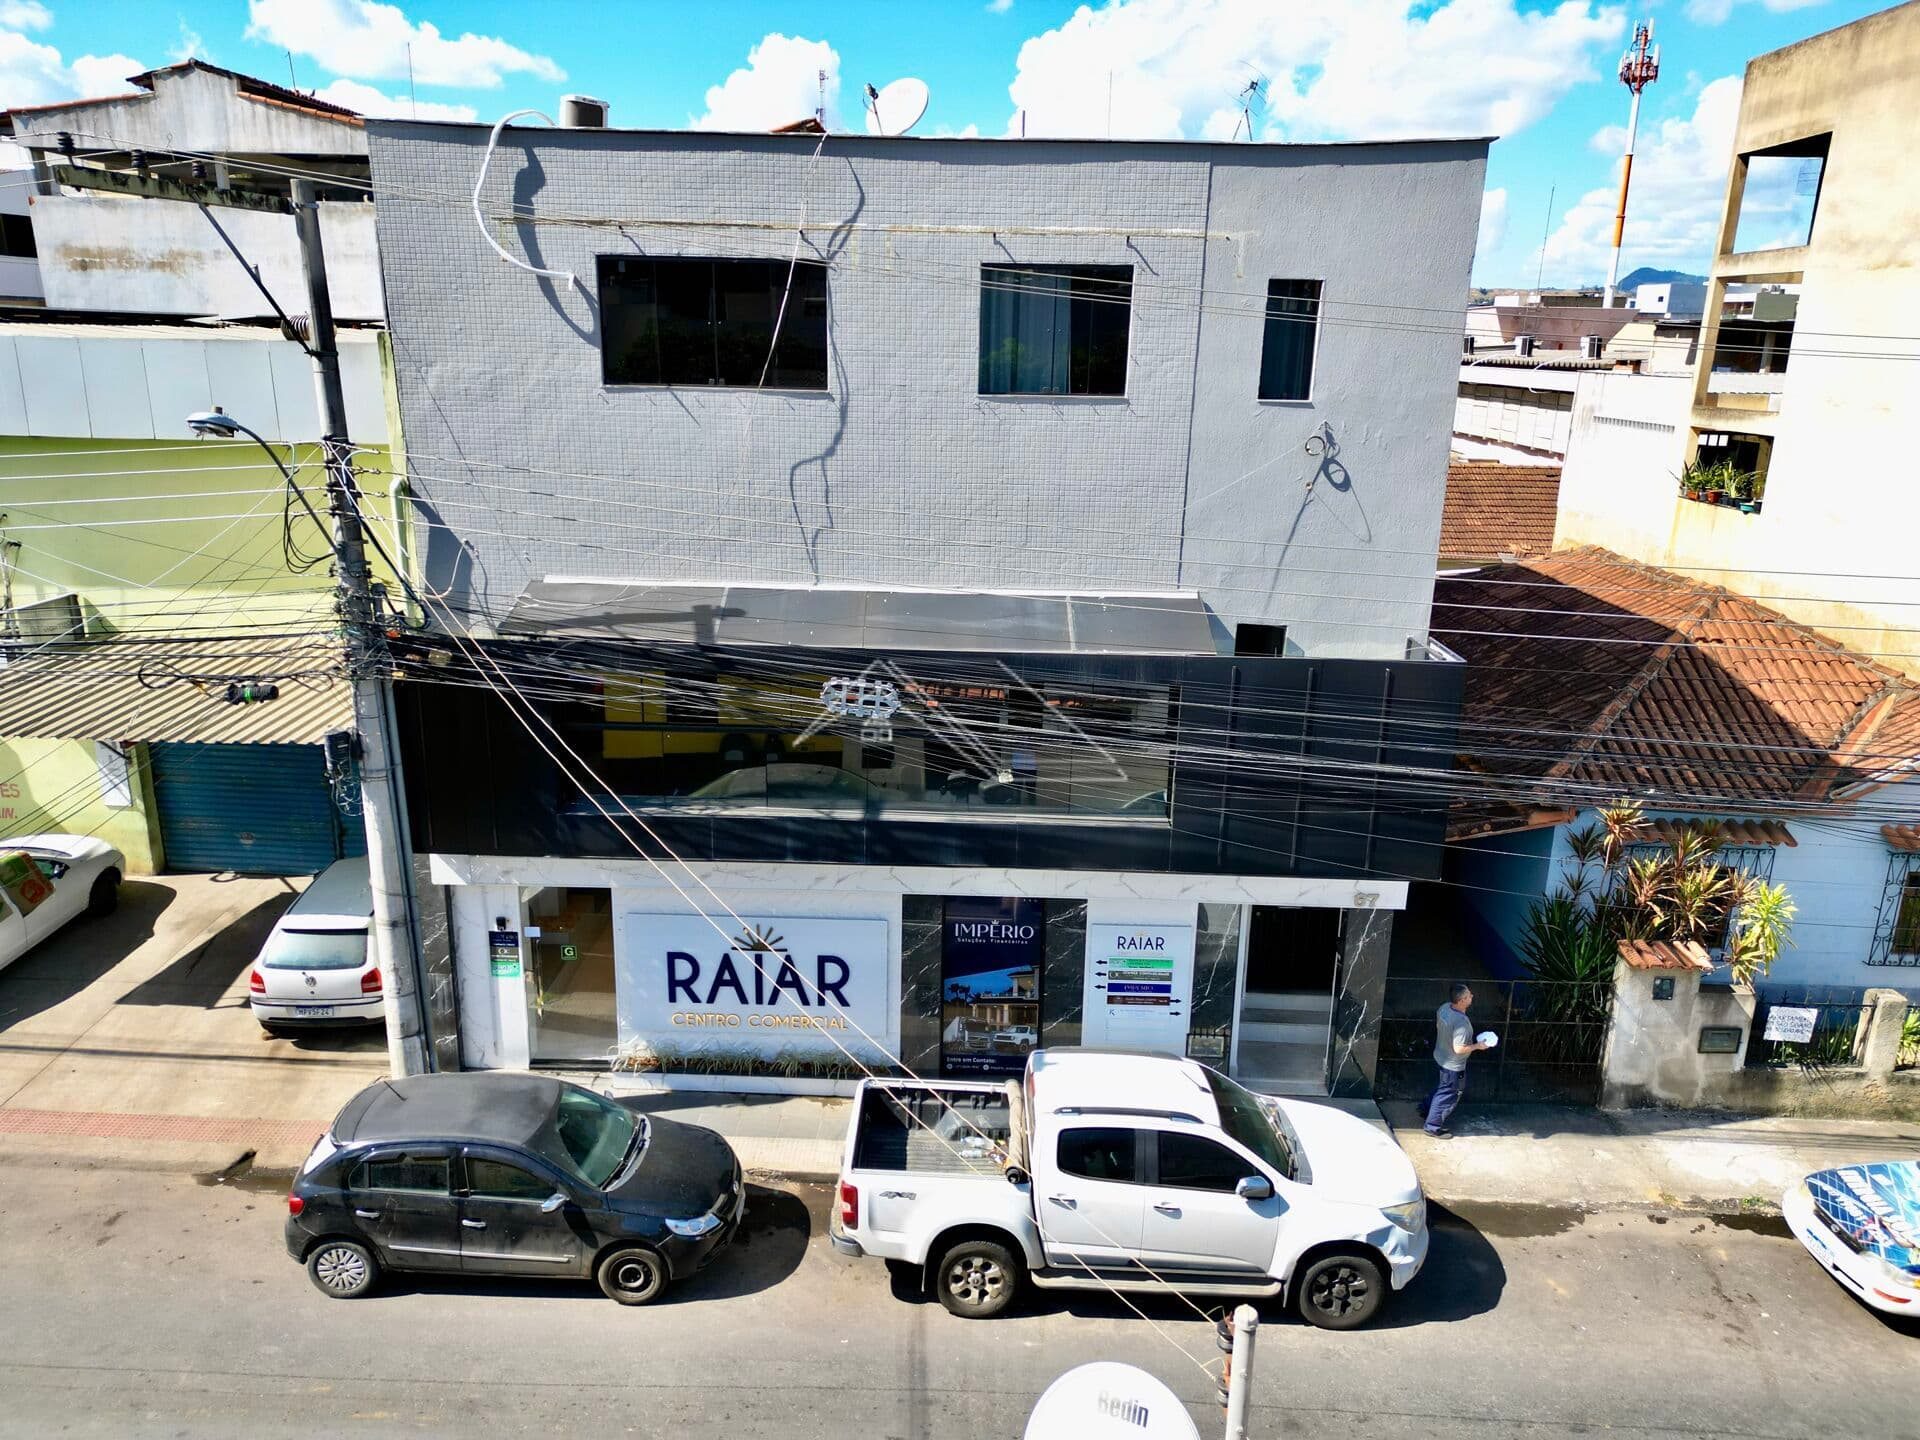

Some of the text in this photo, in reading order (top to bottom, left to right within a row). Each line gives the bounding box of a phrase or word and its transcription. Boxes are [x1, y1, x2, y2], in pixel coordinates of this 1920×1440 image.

[0, 807, 18, 819] IN.
[1354, 892, 1380, 907] 67
[1117, 935, 1165, 951] RAIAR
[666, 951, 851, 1007] RAIAR
[671, 1012, 848, 1031] CENTRO COMERCIAL
[1098, 1390, 1149, 1429] Bedin
